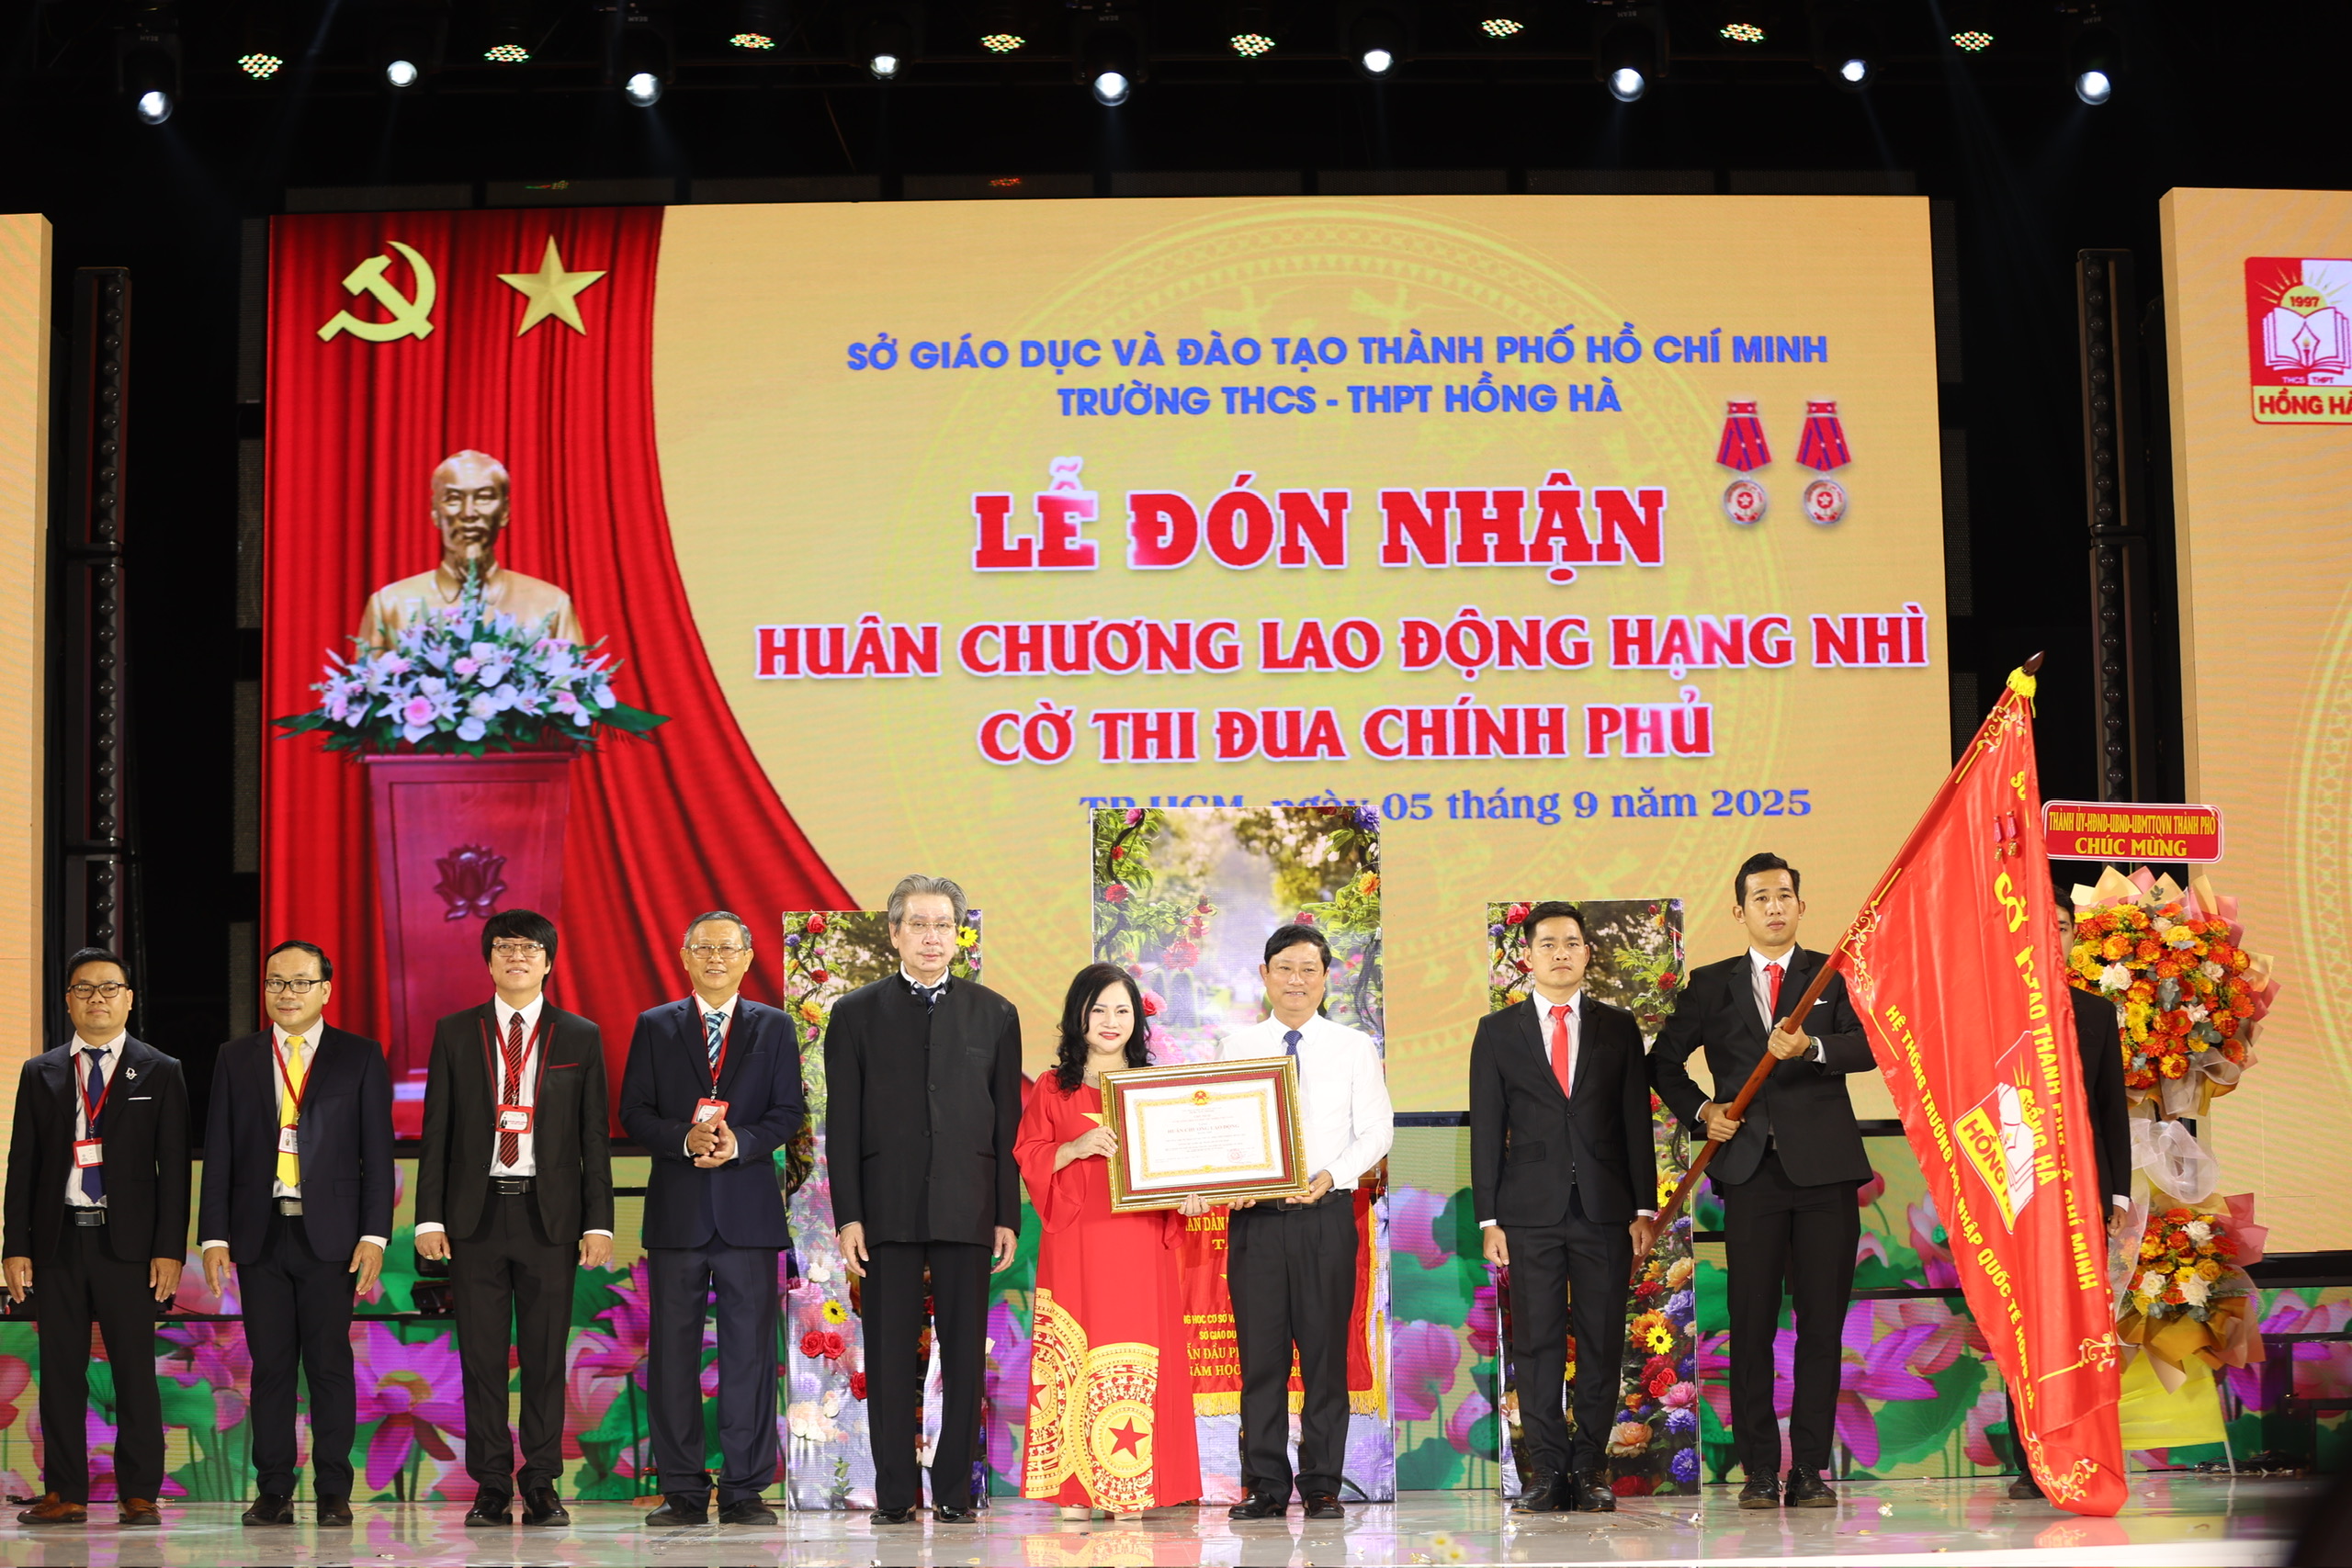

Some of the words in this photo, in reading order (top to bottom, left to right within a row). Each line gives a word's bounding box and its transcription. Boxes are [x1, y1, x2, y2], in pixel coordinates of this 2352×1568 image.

[2290, 296, 2320, 308] 1997
[847, 332, 899, 370] SỞ
[910, 333, 1009, 369] GIÁO
[1021, 339, 1101, 376] DỤC
[1112, 331, 1165, 367] VÀ
[1177, 330, 1261, 366] ĐÀO
[1272, 336, 1348, 373] TẠO
[1358, 328, 1484, 364] THÀNH
[1497, 324, 1576, 364] PHỐ
[1587, 321, 1642, 364] HỒ
[1654, 328, 1722, 364] CHÍ
[1733, 335, 1827, 363] MINH
[1057, 379, 1211, 416] TRƯỜNG
[1221, 386, 1317, 414] THCS
[1326, 399, 1339, 407] -
[1347, 384, 1433, 413] THPT
[1445, 371, 1558, 412] HỒNG
[1569, 376, 1623, 412] HÀ
[2281, 376, 2306, 384] THCS
[2259, 388, 2324, 414] HỒNG
[974, 457, 1097, 570] LỄ
[1128, 473, 1350, 569] ĐÓN
[1379, 471, 1666, 582] NHẬN
[758, 613, 939, 678] HUÂN
[960, 617, 1240, 675] CHƯƠNG
[1260, 619, 1382, 671] LAO
[1399, 606, 1591, 680] ĐỘNG
[1611, 615, 1793, 678] HẠNG
[1812, 604, 1928, 667] NHÌ
[979, 701, 1075, 763] CỜ
[1091, 709, 1196, 761] THI
[1215, 709, 1348, 761] ĐUA
[1363, 695, 1567, 760] CHÍNH
[1585, 689, 1713, 757] PHỦ
[1382, 792, 1433, 820] 05
[1447, 788, 1561, 825] tháng
[1574, 791, 1599, 818] 9
[1612, 787, 1697, 818] năm
[1712, 789, 1812, 817] 2025
[2049, 807, 2075, 831] THÀNH
[2173, 811, 2199, 835] THÀNH
[2075, 834, 2126, 855] CHÚC
[2131, 836, 2188, 857] MỪNG
[1884, 1004, 1907, 1032] HỆ
[1900, 1029, 1928, 1091] THỐNG
[1921, 1089, 1953, 1163] TRƯỜNG
[1956, 1196, 1984, 1246] NHẬP
[1976, 1247, 2012, 1298] QUỐC
[2007, 1297, 2023, 1325] TẾ
[1962, 1118, 2006, 1186] HỒNG
[2033, 1154, 2061, 1187] HÀ
[1203, 1212, 1226, 1231] DÂN
[2070, 1232, 2099, 1291] MINH
[1192, 1314, 1206, 1326] HỌC
[1207, 1314, 1217, 1324] CƠ
[1217, 1310, 1227, 1324] SỞ
[1199, 1327, 1209, 1340] SỞ
[1209, 1327, 1227, 1340] GIÁO
[1203, 1342, 1226, 1359] ĐẦU
[1215, 1363, 1242, 1379] HỌC
